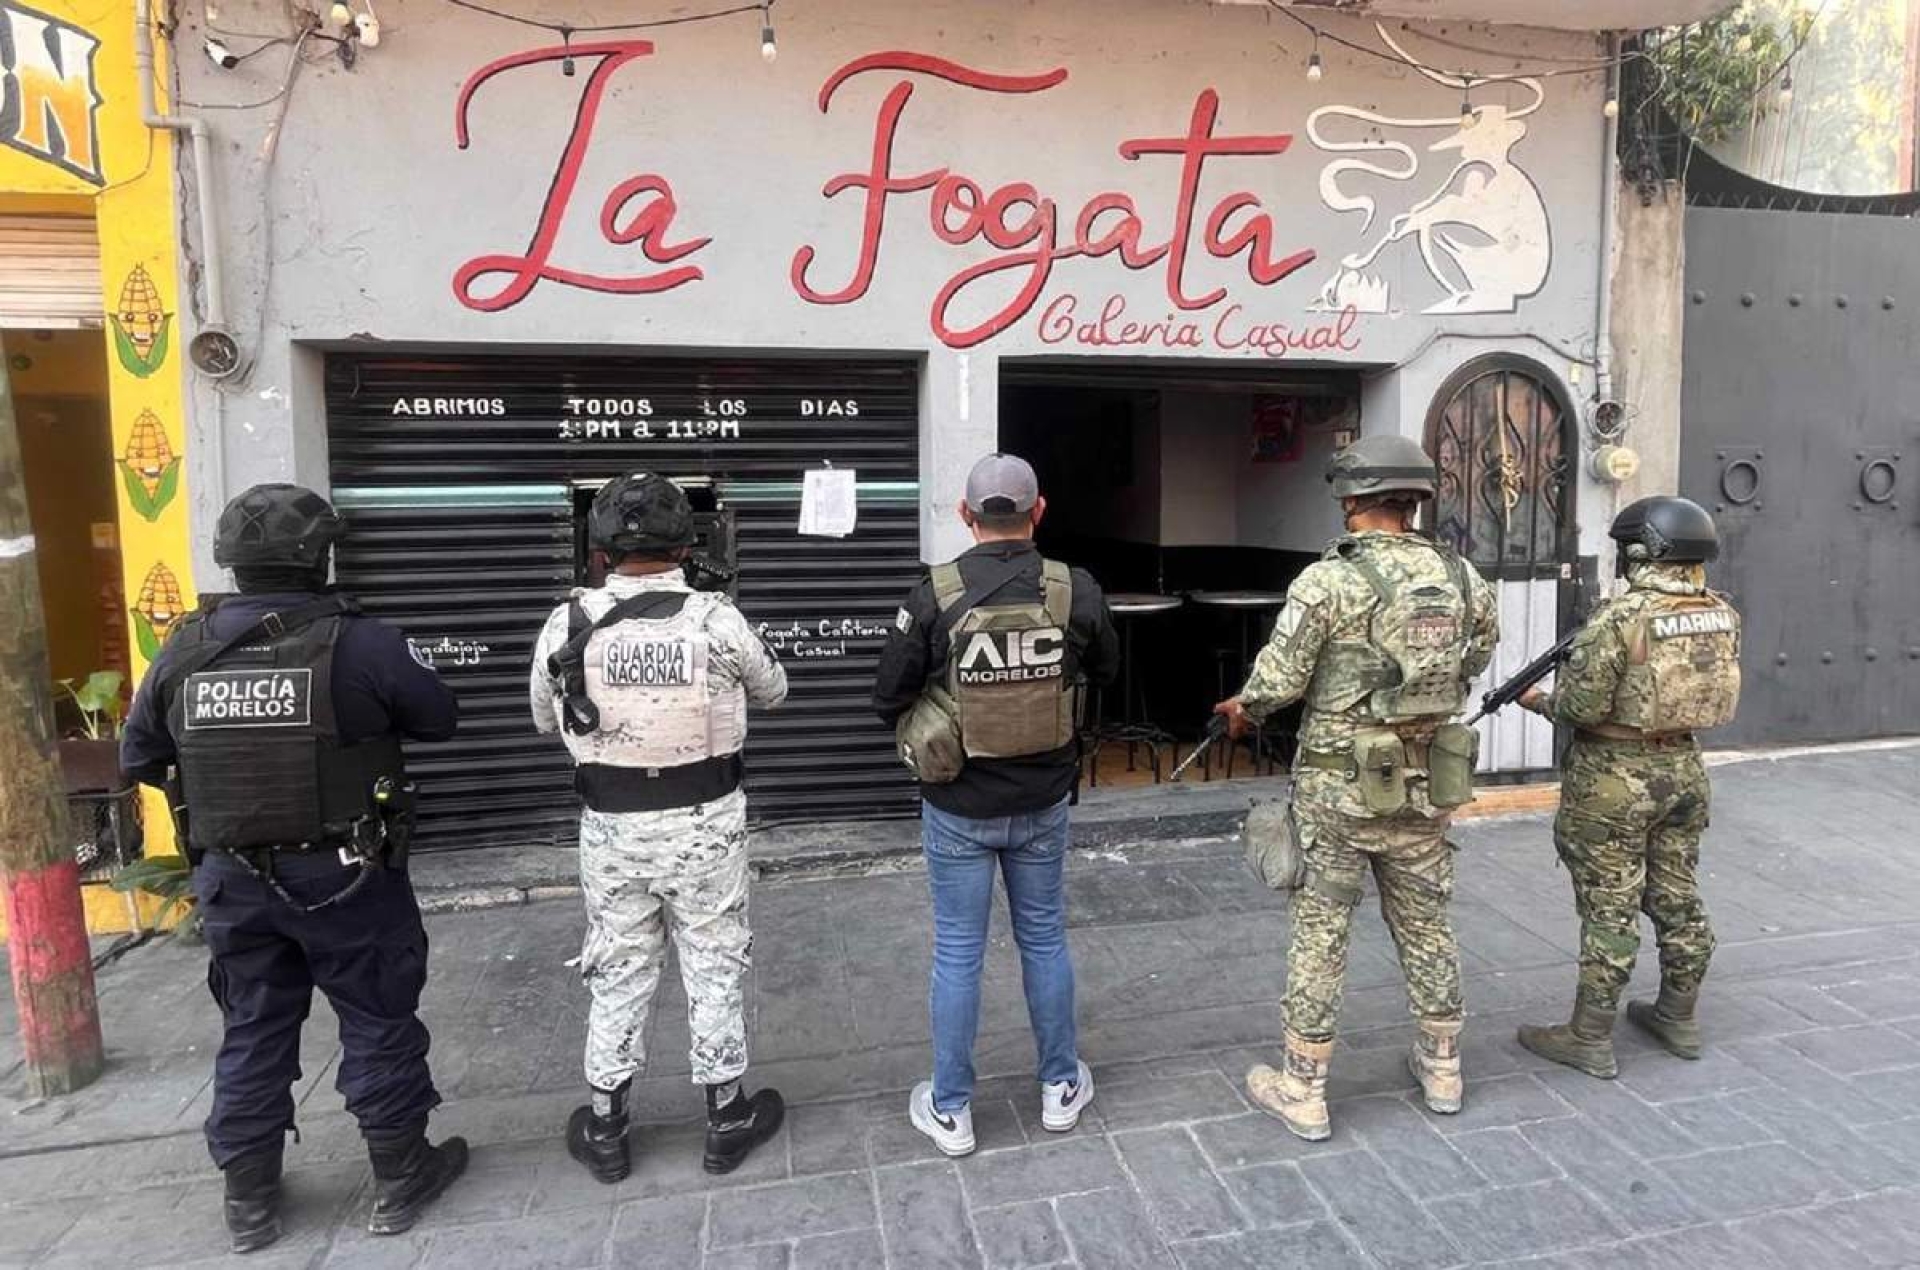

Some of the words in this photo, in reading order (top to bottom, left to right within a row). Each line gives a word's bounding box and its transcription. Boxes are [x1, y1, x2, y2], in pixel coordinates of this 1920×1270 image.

[0, 7, 99, 175] N
[452, 40, 713, 312] La
[791, 49, 1316, 349] Fogata
[1037, 293, 1203, 347] Galeria
[1213, 303, 1362, 357] Casual
[392, 397, 505, 415] ABRIMOS
[567, 398, 653, 415] TODOS
[702, 399, 747, 415] LOS
[800, 399, 859, 416] DIAS
[632, 419, 655, 438] a
[606, 642, 685, 664] GUARDIA
[793, 640, 846, 656] Casual
[958, 627, 1064, 669] AIC
[606, 662, 689, 684] NACIONAL
[960, 664, 1062, 683] MORELOS
[196, 674, 296, 702] POLICÍA
[195, 698, 295, 719] MORELOS
